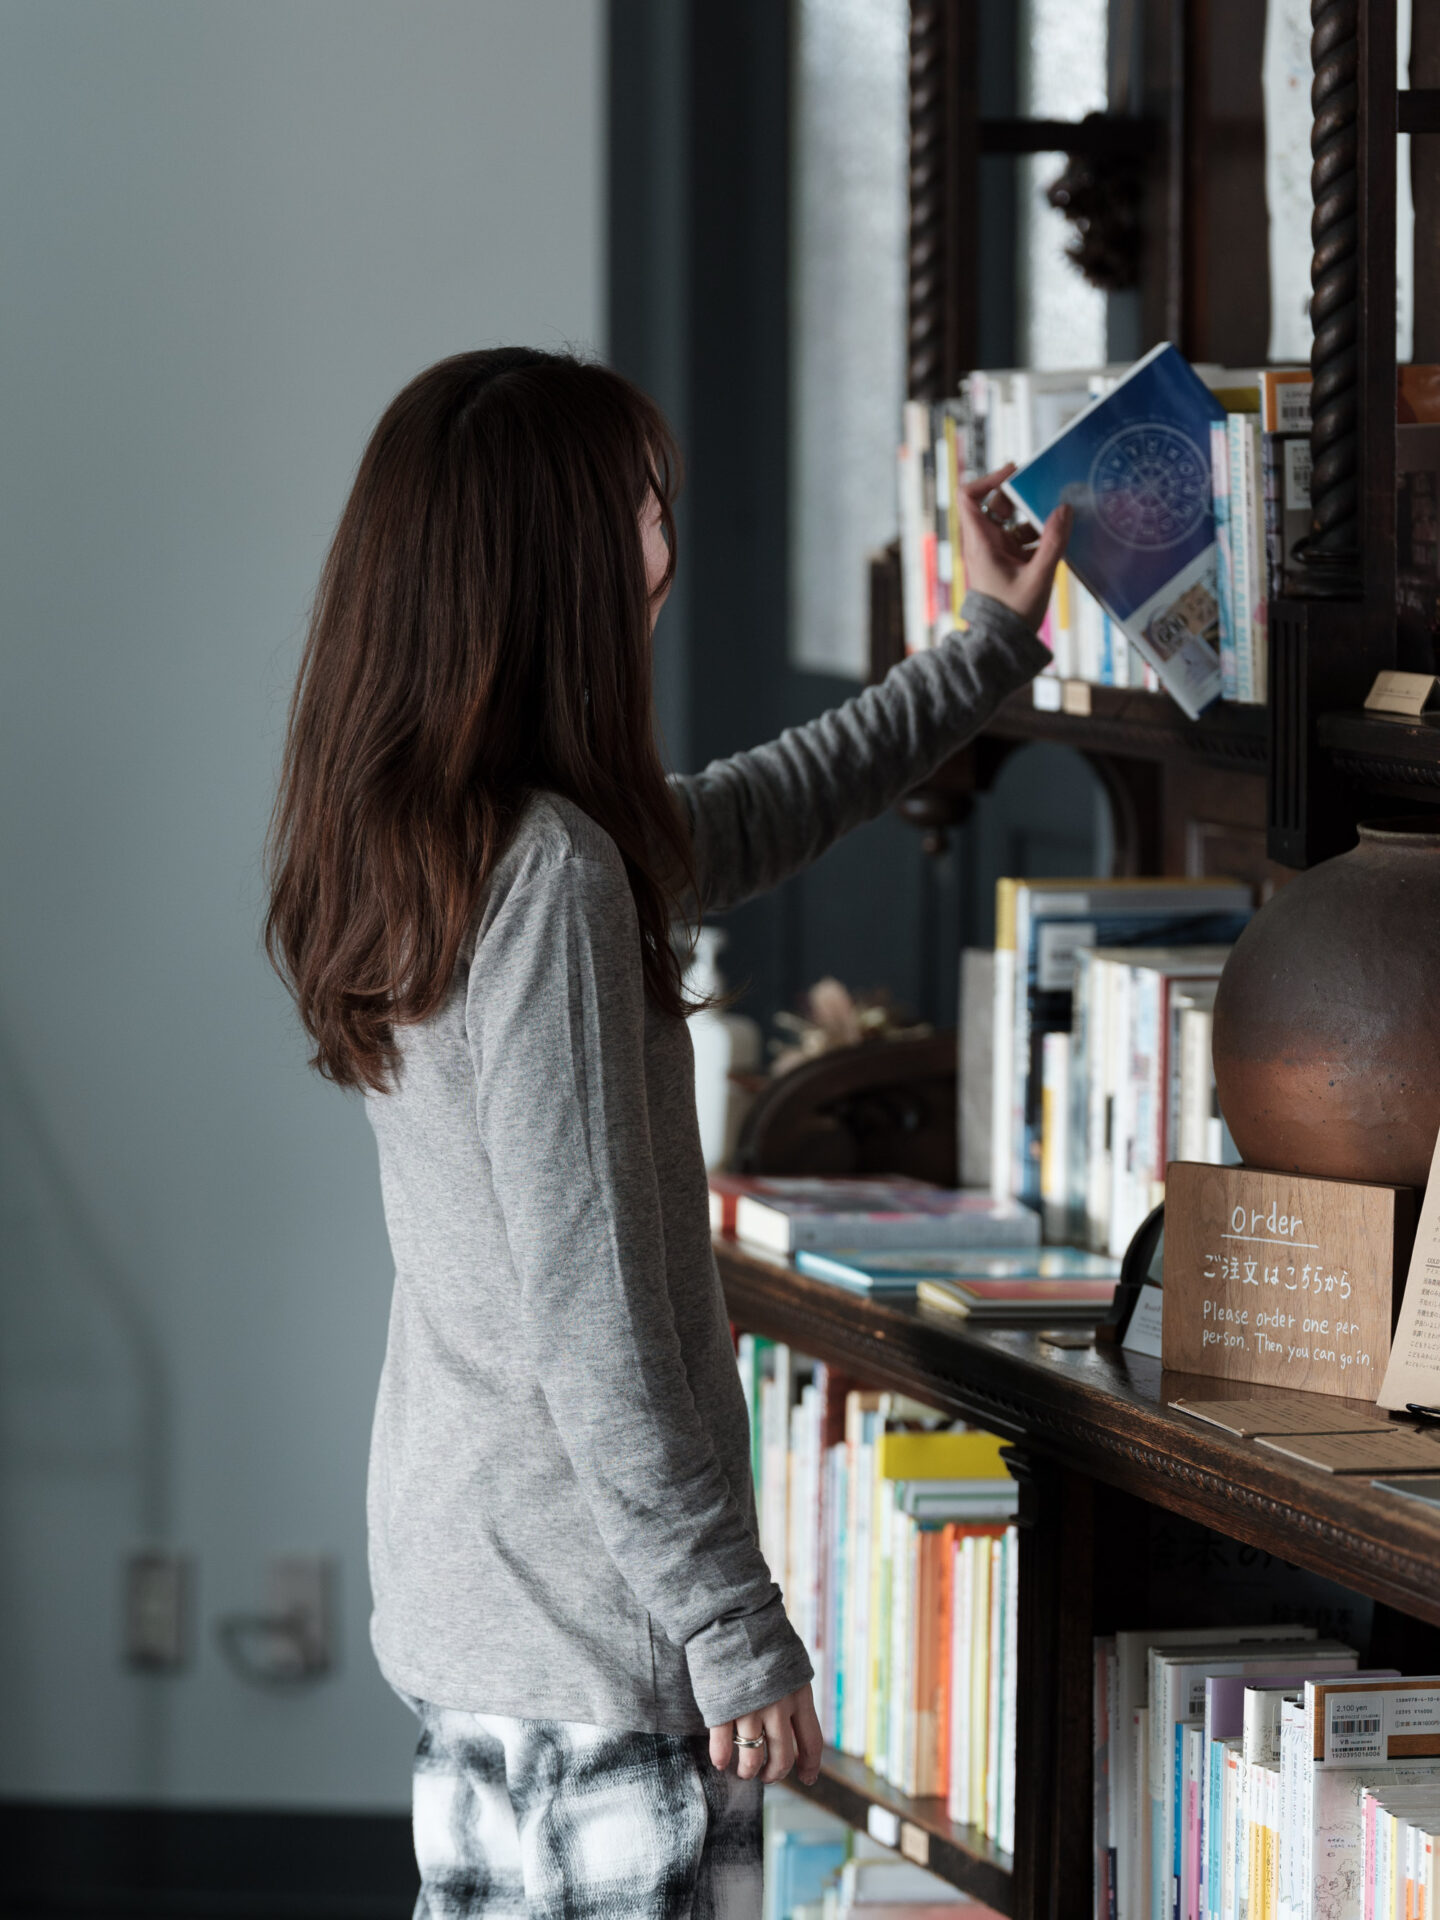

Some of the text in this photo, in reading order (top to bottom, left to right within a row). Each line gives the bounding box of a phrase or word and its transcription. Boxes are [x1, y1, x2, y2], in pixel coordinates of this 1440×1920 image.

[1231, 1201, 1304, 1237] Order
[1203, 1254, 1351, 1300] ご注文はこちらから
[1203, 1300, 1360, 1340] Please order one per
[1203, 1329, 1374, 1371] person. Then you can go in.
